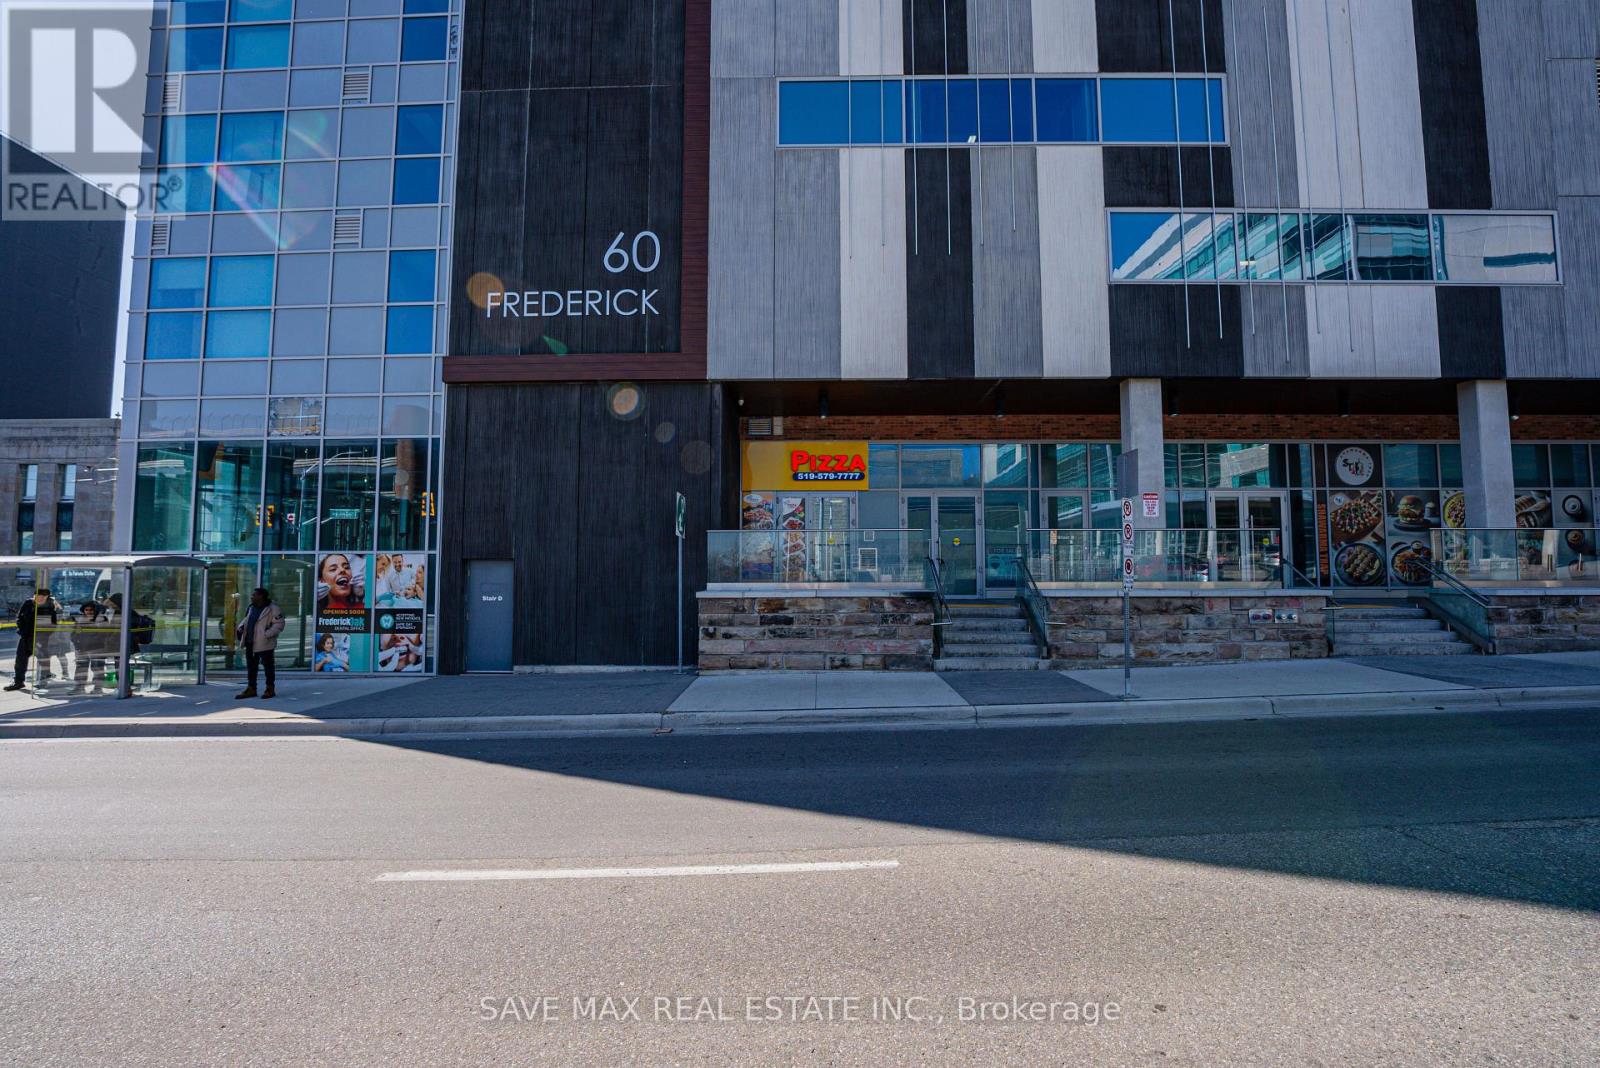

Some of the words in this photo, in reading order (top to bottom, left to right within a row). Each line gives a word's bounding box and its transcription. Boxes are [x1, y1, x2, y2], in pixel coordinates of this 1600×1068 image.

[603, 231, 661, 273] 60
[486, 288, 660, 318] FREDERICK
[797, 472, 861, 480] 519-579-7777
